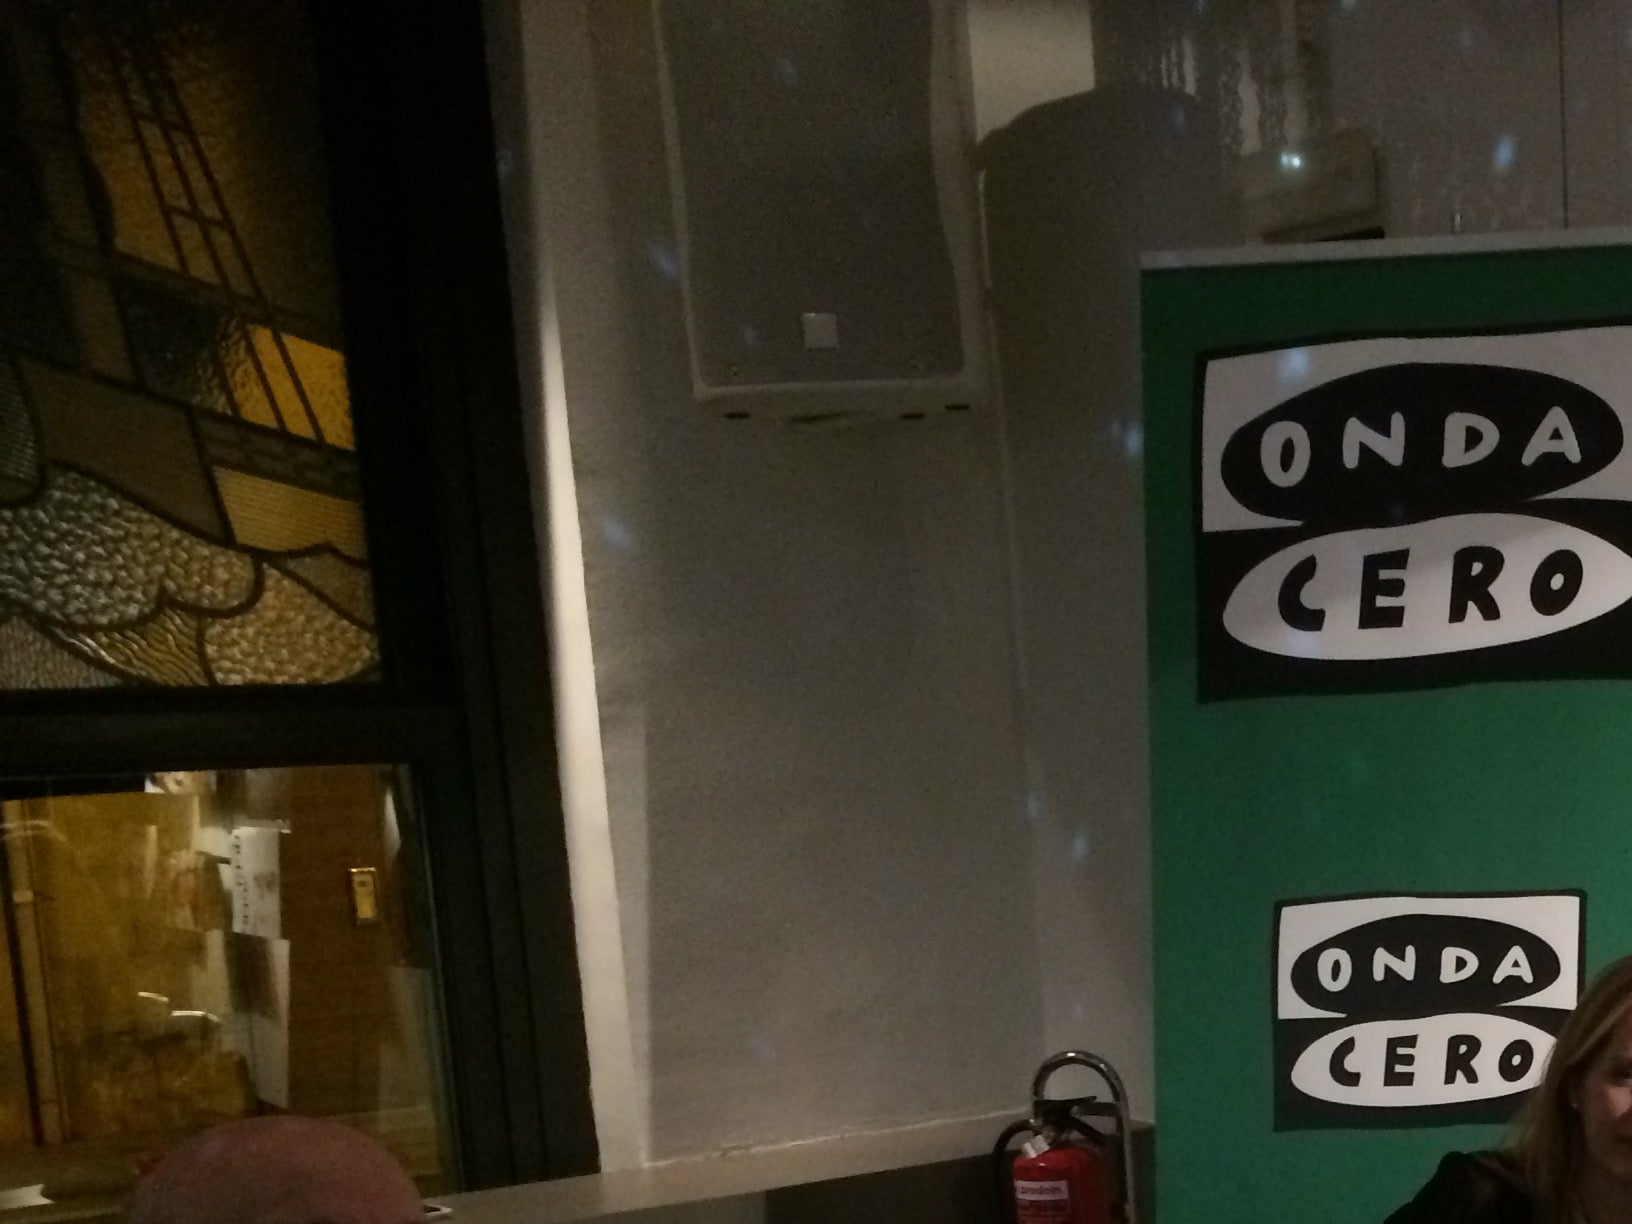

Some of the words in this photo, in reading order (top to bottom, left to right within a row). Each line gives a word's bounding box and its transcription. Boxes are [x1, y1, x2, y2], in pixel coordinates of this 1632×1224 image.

[1260, 406, 1582, 487] ONDA
[1277, 545, 1583, 632] CERO
[1317, 945, 1533, 993] ONDA
[1330, 1034, 1533, 1087] CERO
